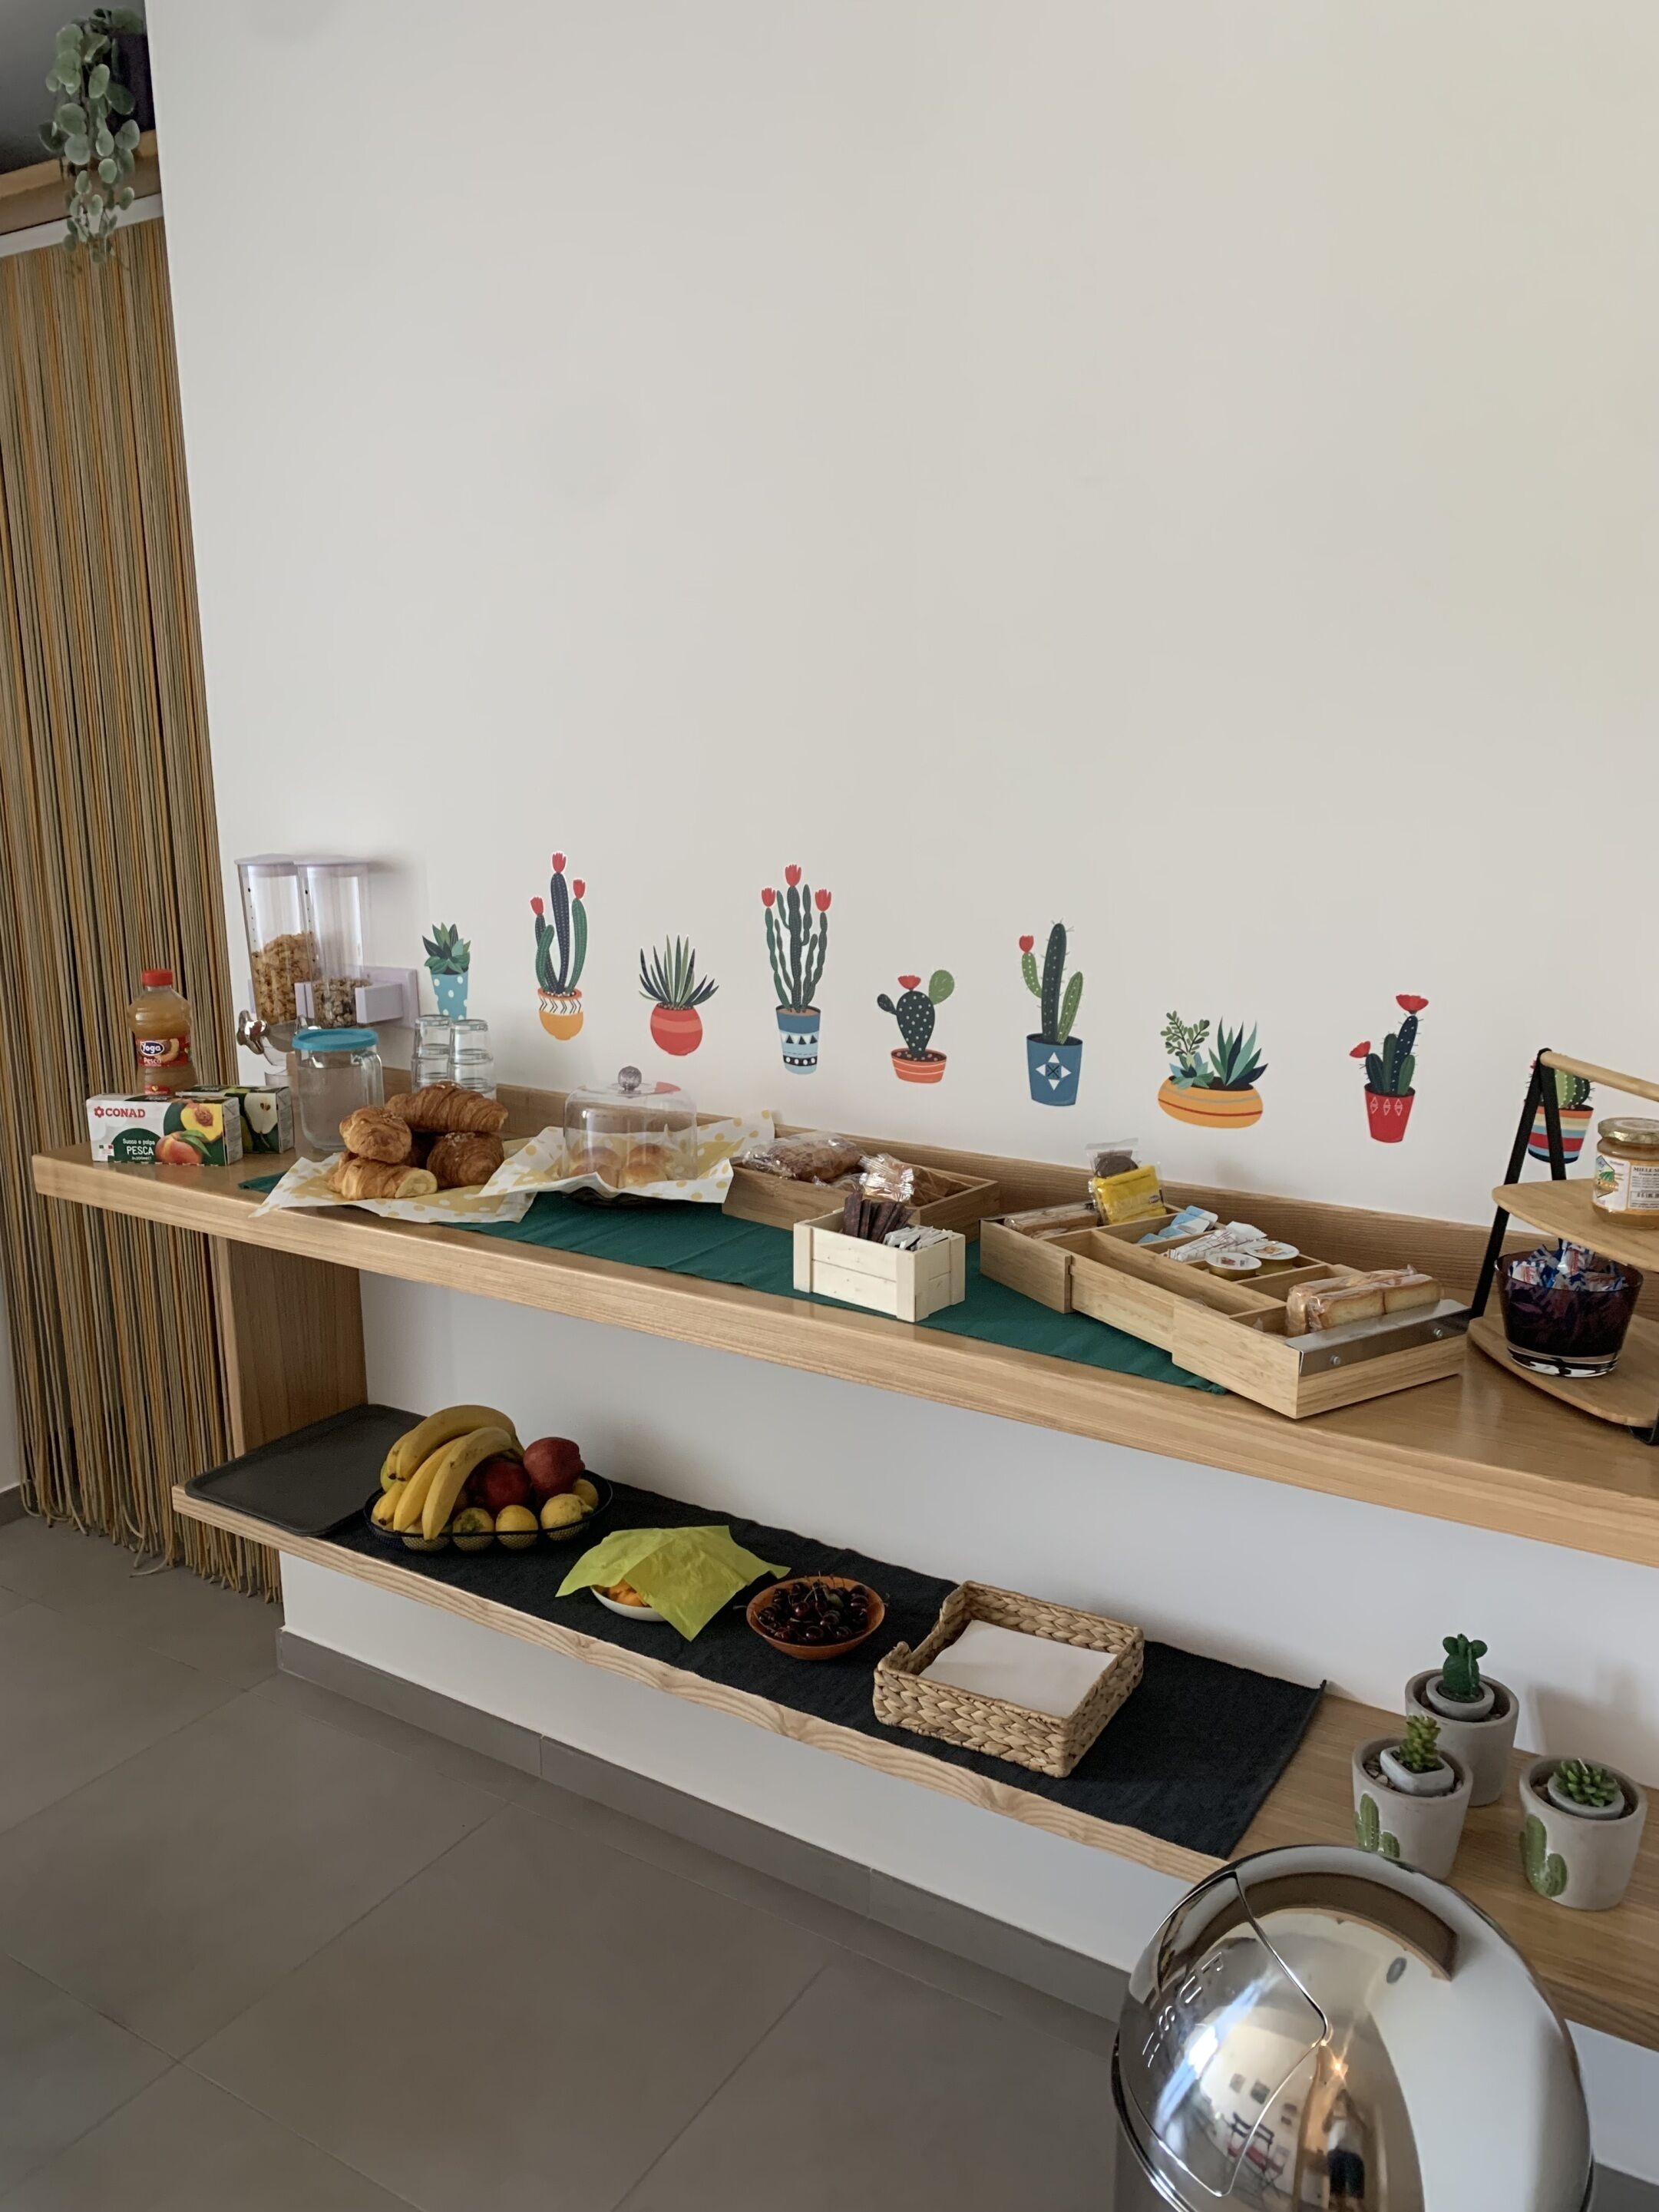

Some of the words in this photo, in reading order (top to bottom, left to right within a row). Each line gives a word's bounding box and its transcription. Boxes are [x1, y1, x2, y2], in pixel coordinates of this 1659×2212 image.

[142, 1043, 161, 1054] Yoga
[105, 1108, 146, 1118] CONAD
[126, 1146, 154, 1156] PESCA
